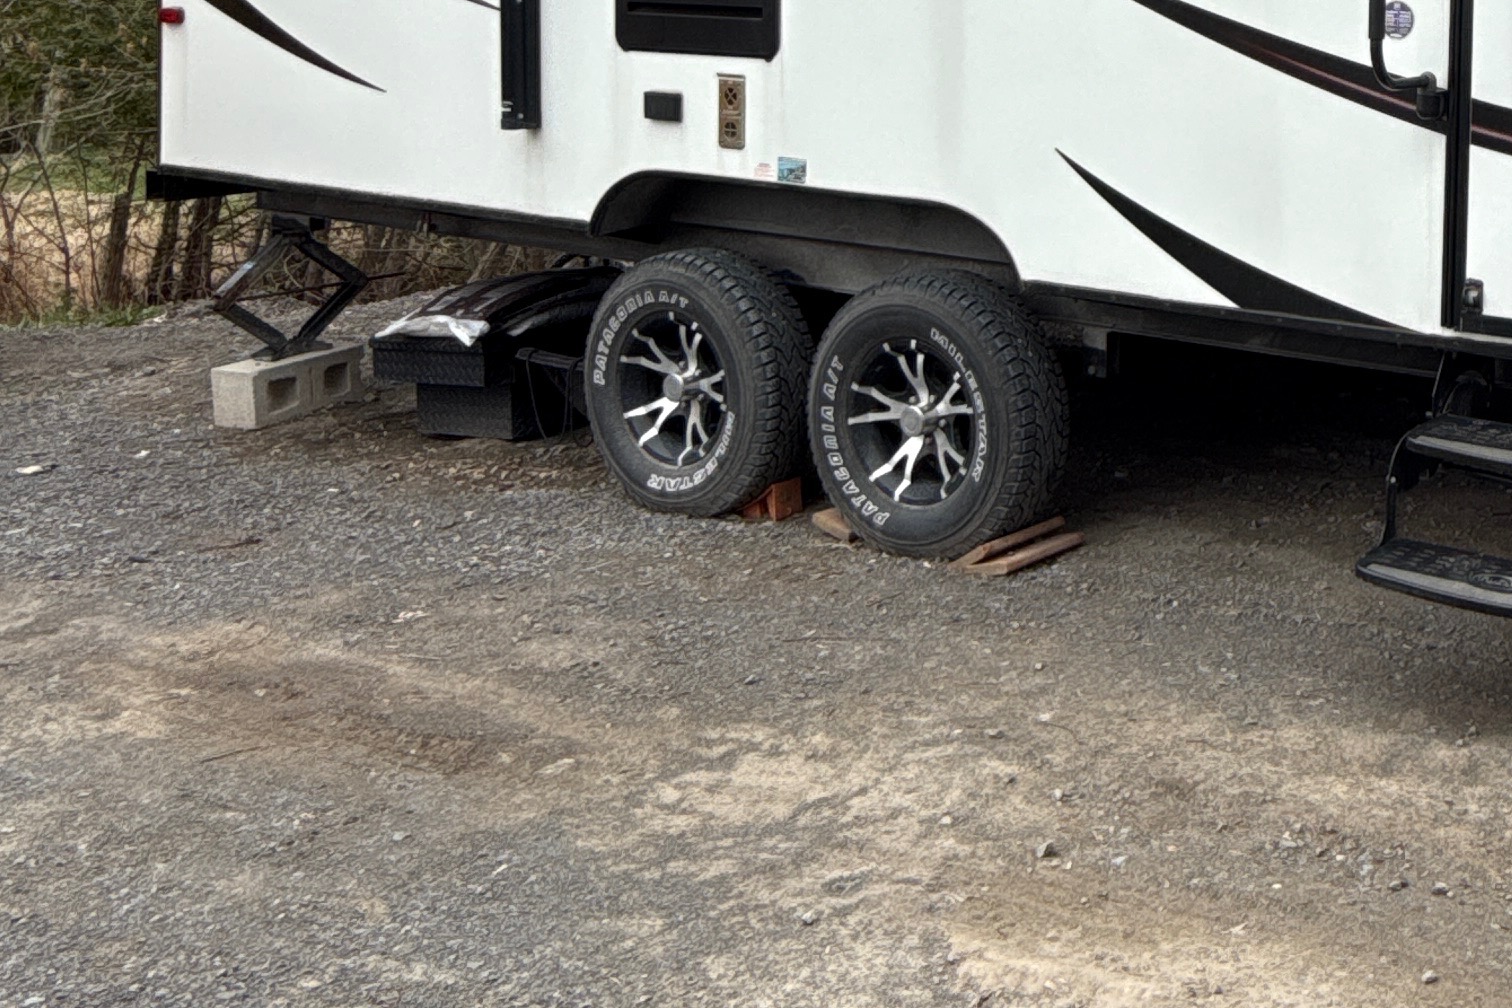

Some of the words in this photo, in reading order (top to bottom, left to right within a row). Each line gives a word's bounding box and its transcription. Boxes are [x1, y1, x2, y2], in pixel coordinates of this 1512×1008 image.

[593, 290, 655, 386] PATAGONIA
[658, 290, 689, 309] A/T
[822, 354, 844, 401] A/T
[820, 405, 891, 526] PATAGONIA
